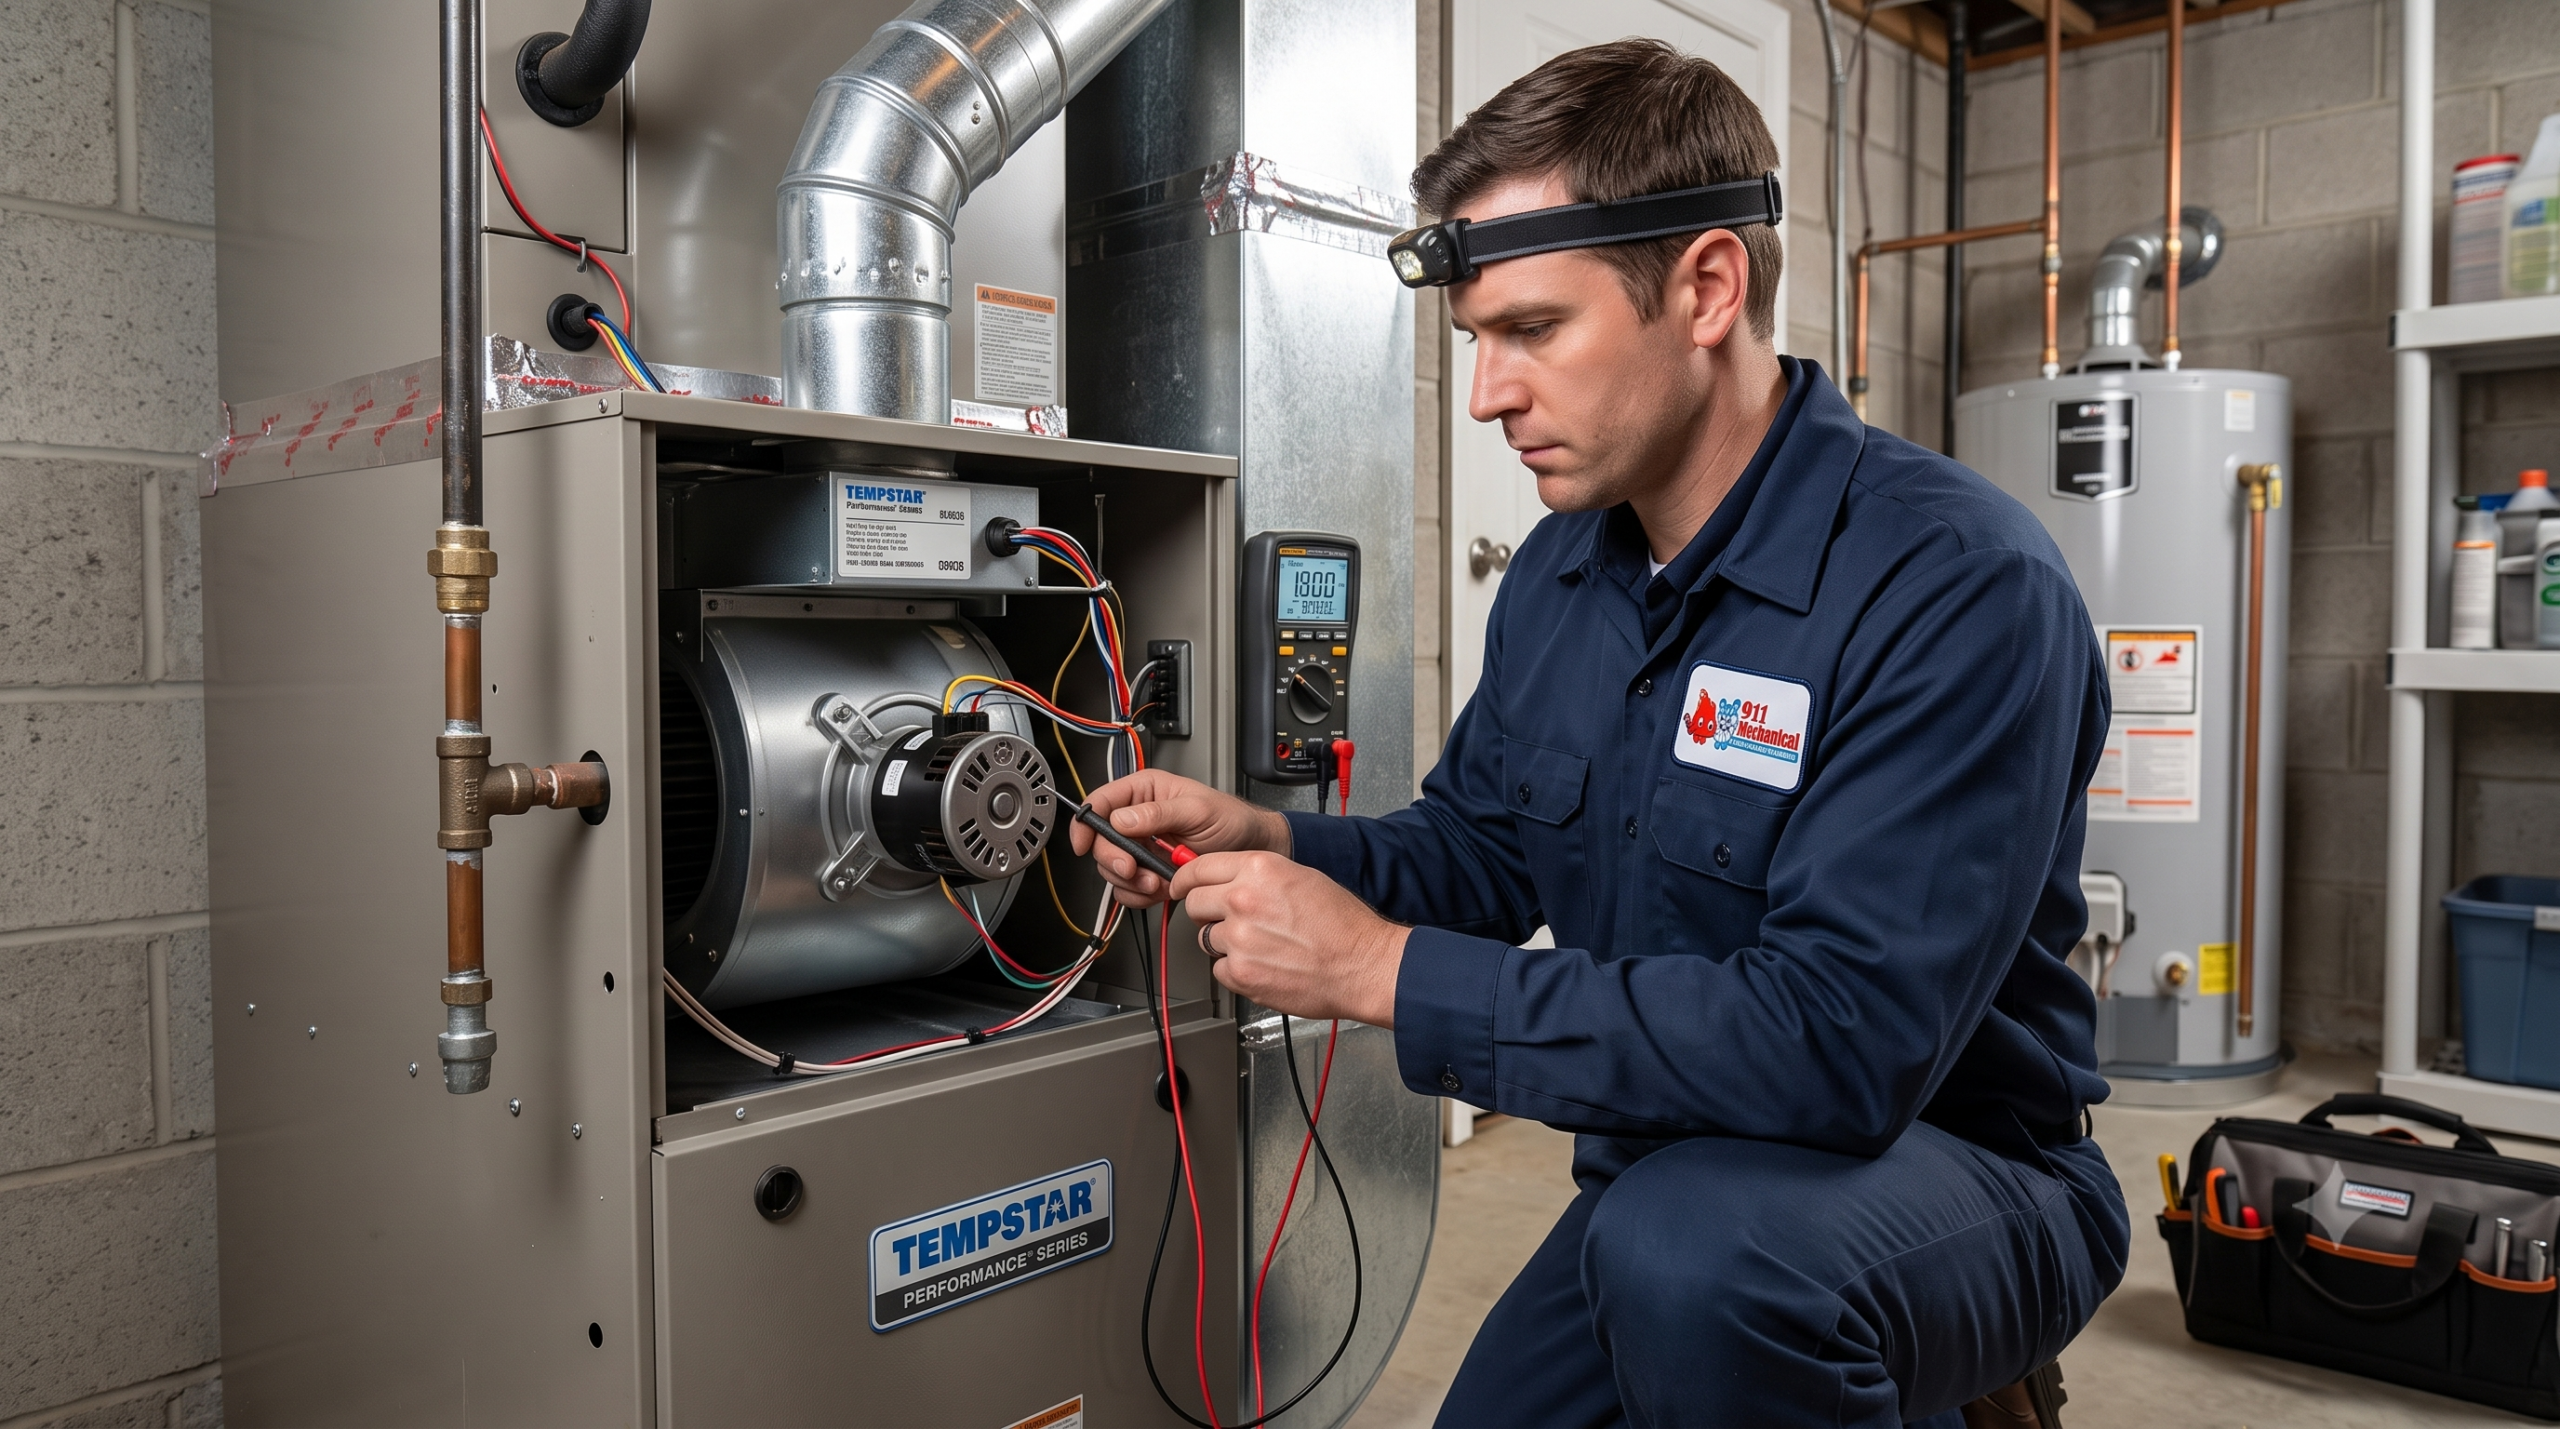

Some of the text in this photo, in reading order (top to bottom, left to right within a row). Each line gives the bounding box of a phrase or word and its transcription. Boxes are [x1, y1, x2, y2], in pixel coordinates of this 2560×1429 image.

[1294, 571, 1336, 598] 1800
[1740, 700, 1769, 725] 911
[1735, 720, 1801, 751] Mechanical
[1036, 1231, 1089, 1262] SERIES
